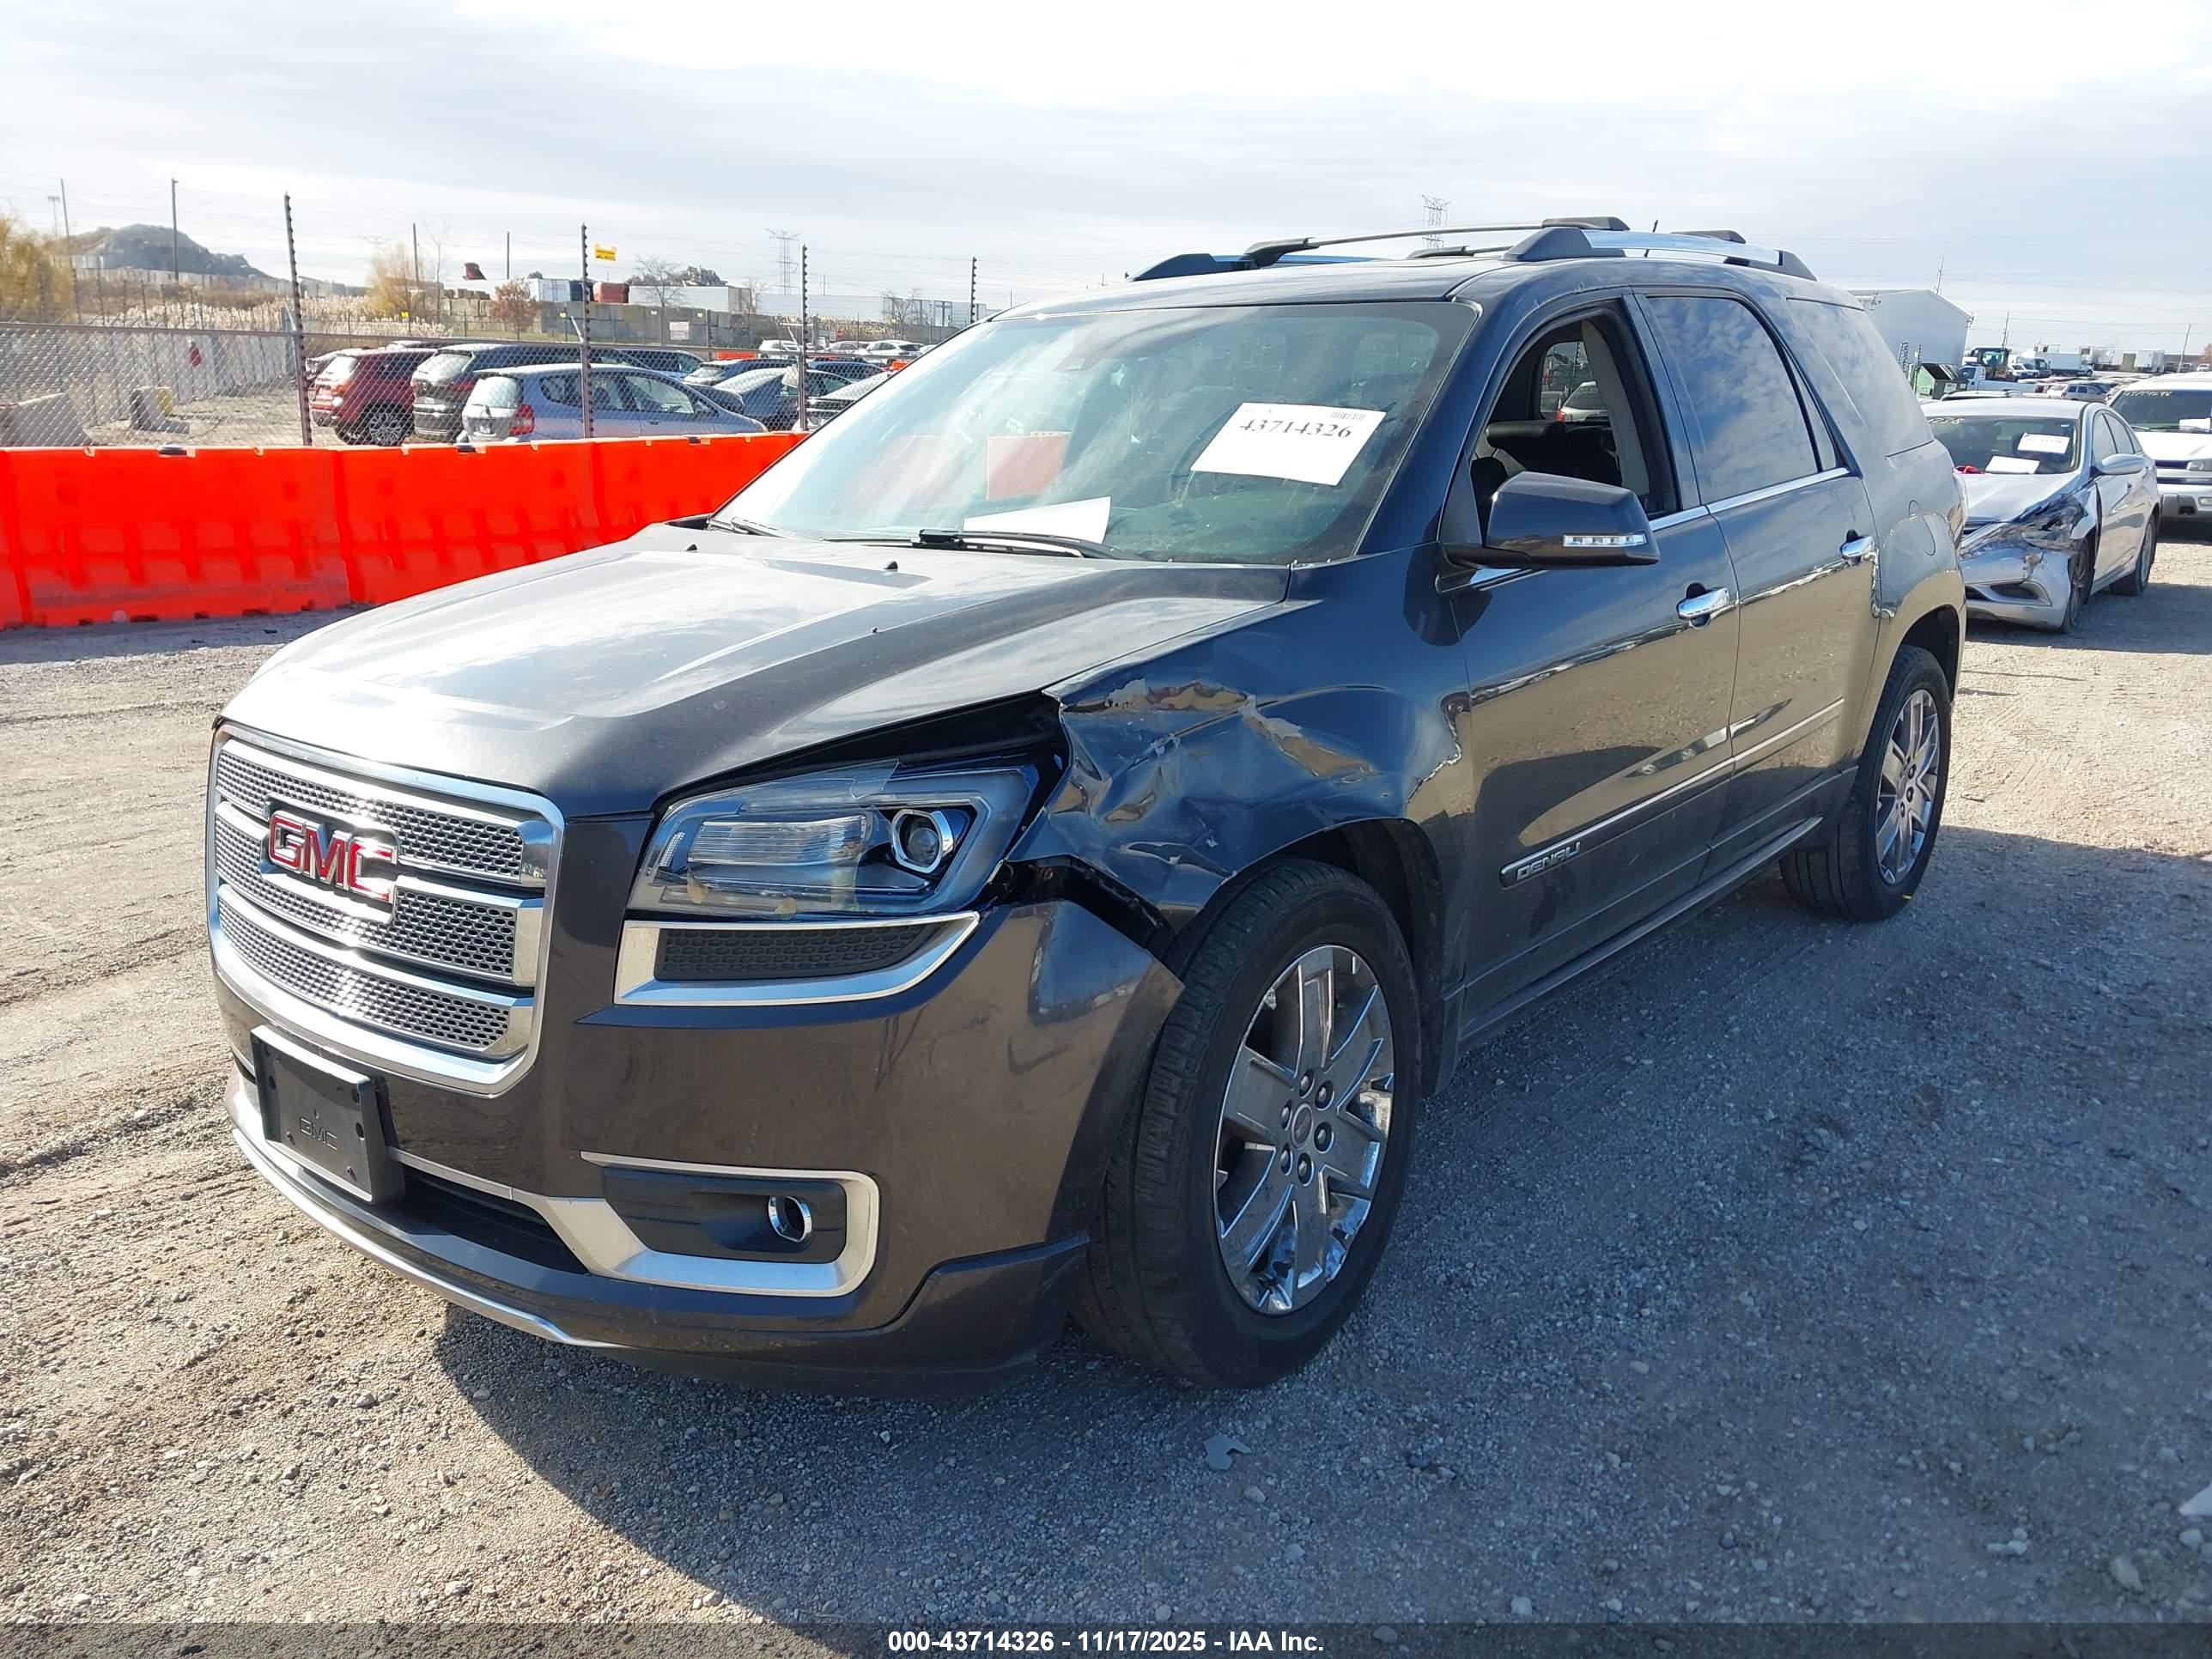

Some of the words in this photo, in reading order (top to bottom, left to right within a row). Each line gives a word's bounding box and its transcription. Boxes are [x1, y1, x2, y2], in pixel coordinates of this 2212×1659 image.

[1240, 419, 1353, 438] 43714326
[269, 810, 398, 904] GMC
[1516, 842, 1581, 881] DENALI
[300, 1117, 337, 1151] GMC
